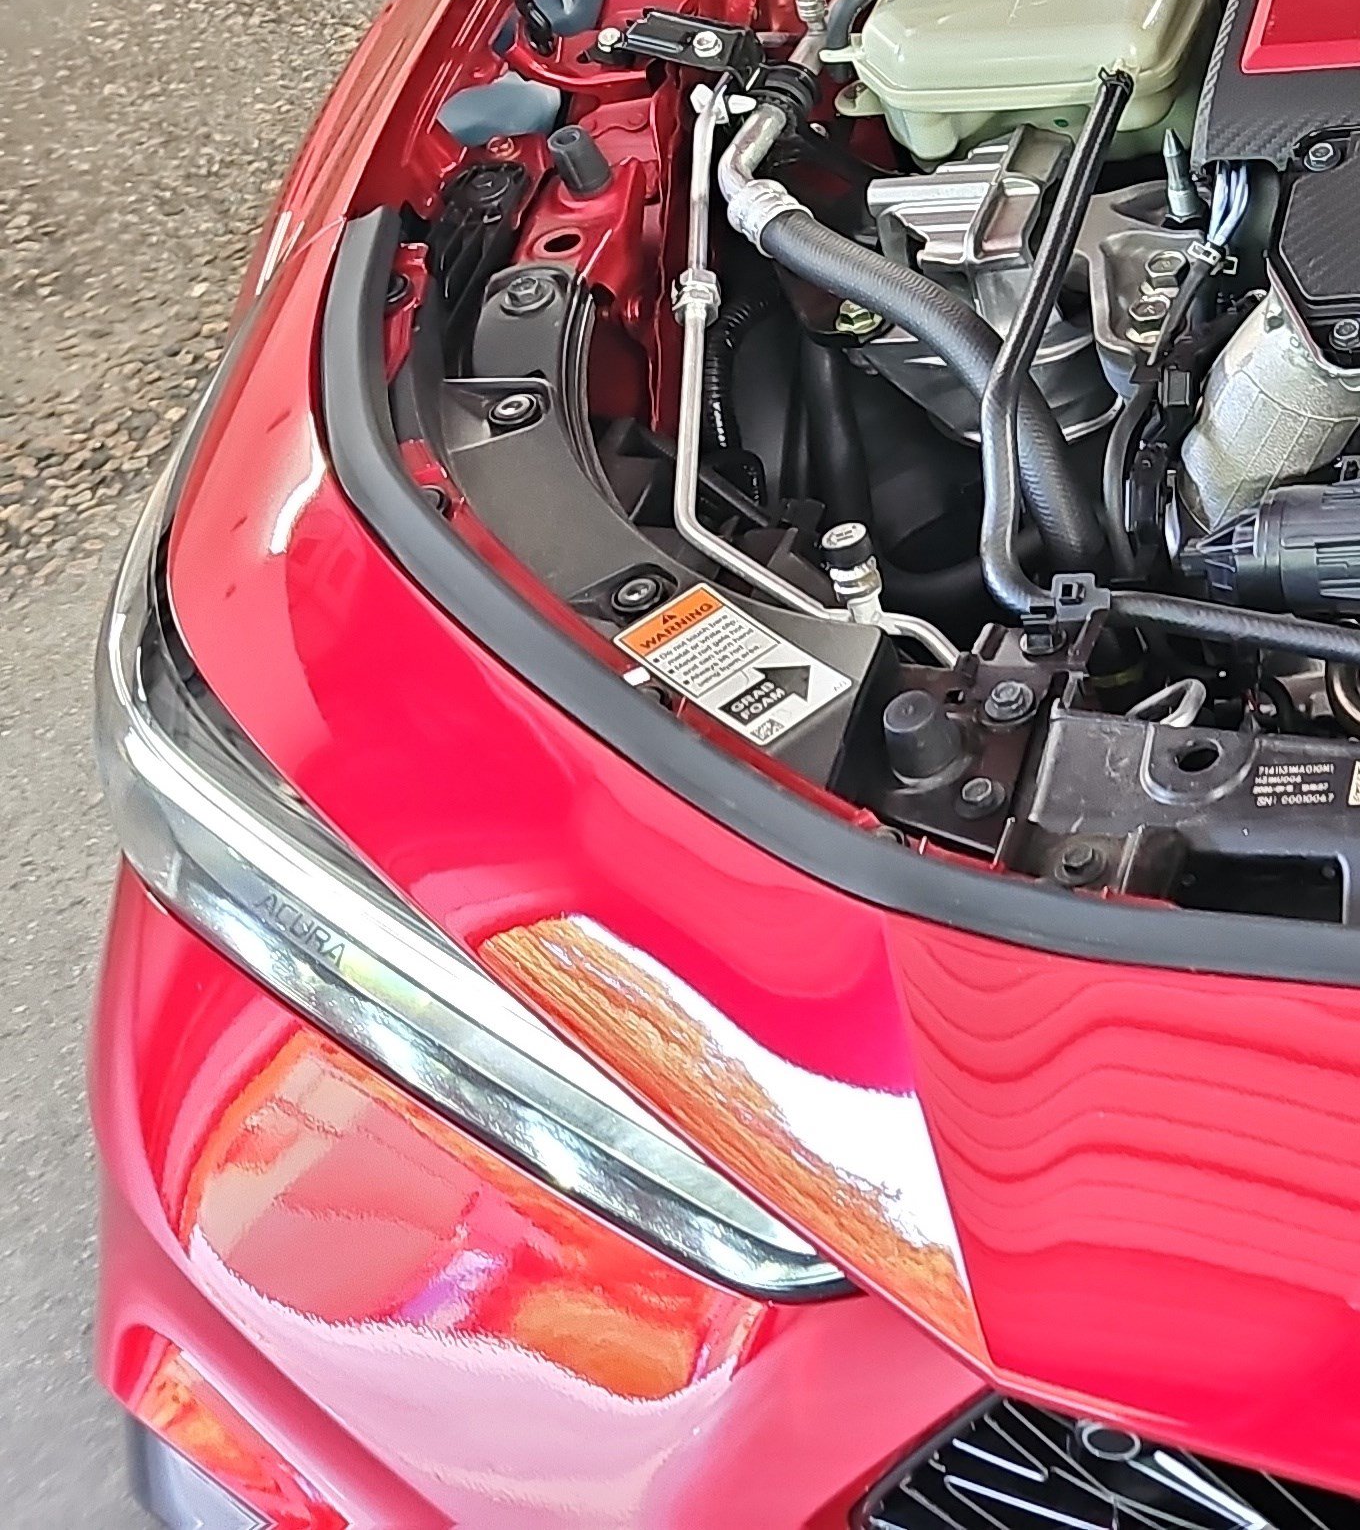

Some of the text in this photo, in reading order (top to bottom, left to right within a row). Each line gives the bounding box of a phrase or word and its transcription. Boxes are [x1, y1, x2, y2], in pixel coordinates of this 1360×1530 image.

[640, 602, 714, 649] WARNING
[673, 640, 687, 652] not
[687, 625, 711, 643] touch
[667, 648, 691, 665] metal
[674, 655, 698, 671] Metal
[729, 624, 745, 637] hot
[682, 664, 699, 677] and
[698, 655, 715, 667] can
[714, 642, 734, 657] burn
[690, 662, 720, 683] Always
[719, 657, 743, 673] foam
[730, 681, 776, 713] GRAB
[739, 687, 786, 720] FOAM
[254, 894, 346, 968] ACURA
